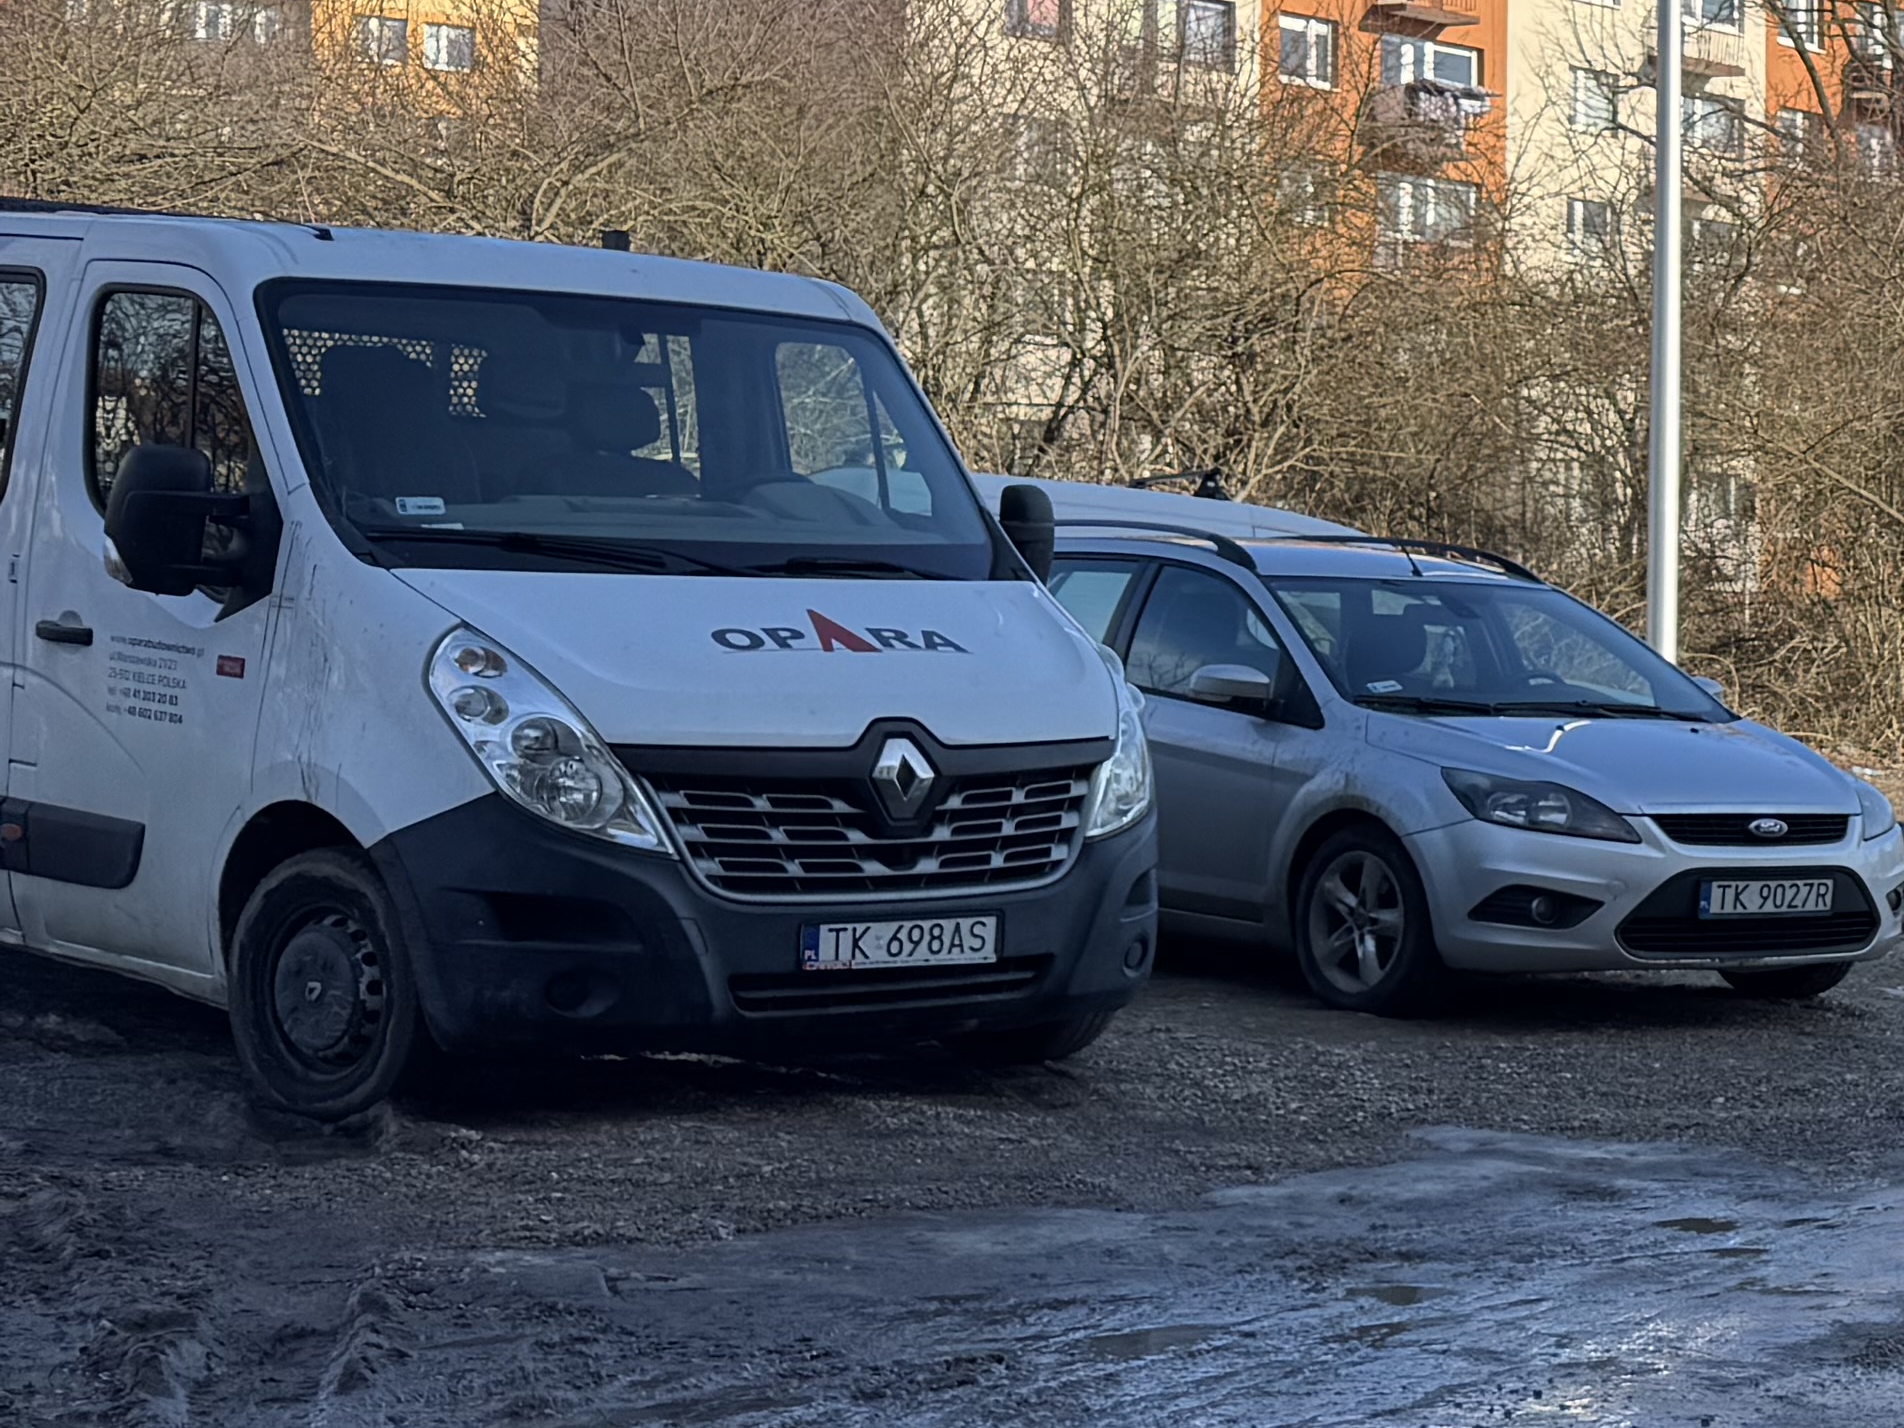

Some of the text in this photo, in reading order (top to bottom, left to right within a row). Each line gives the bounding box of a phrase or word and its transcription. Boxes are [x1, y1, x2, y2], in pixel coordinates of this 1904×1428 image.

[710, 608, 972, 653] OPARA
[1717, 881, 1830, 911] TK 9027R
[828, 925, 872, 961] TK
[886, 920, 988, 958] 698AS
